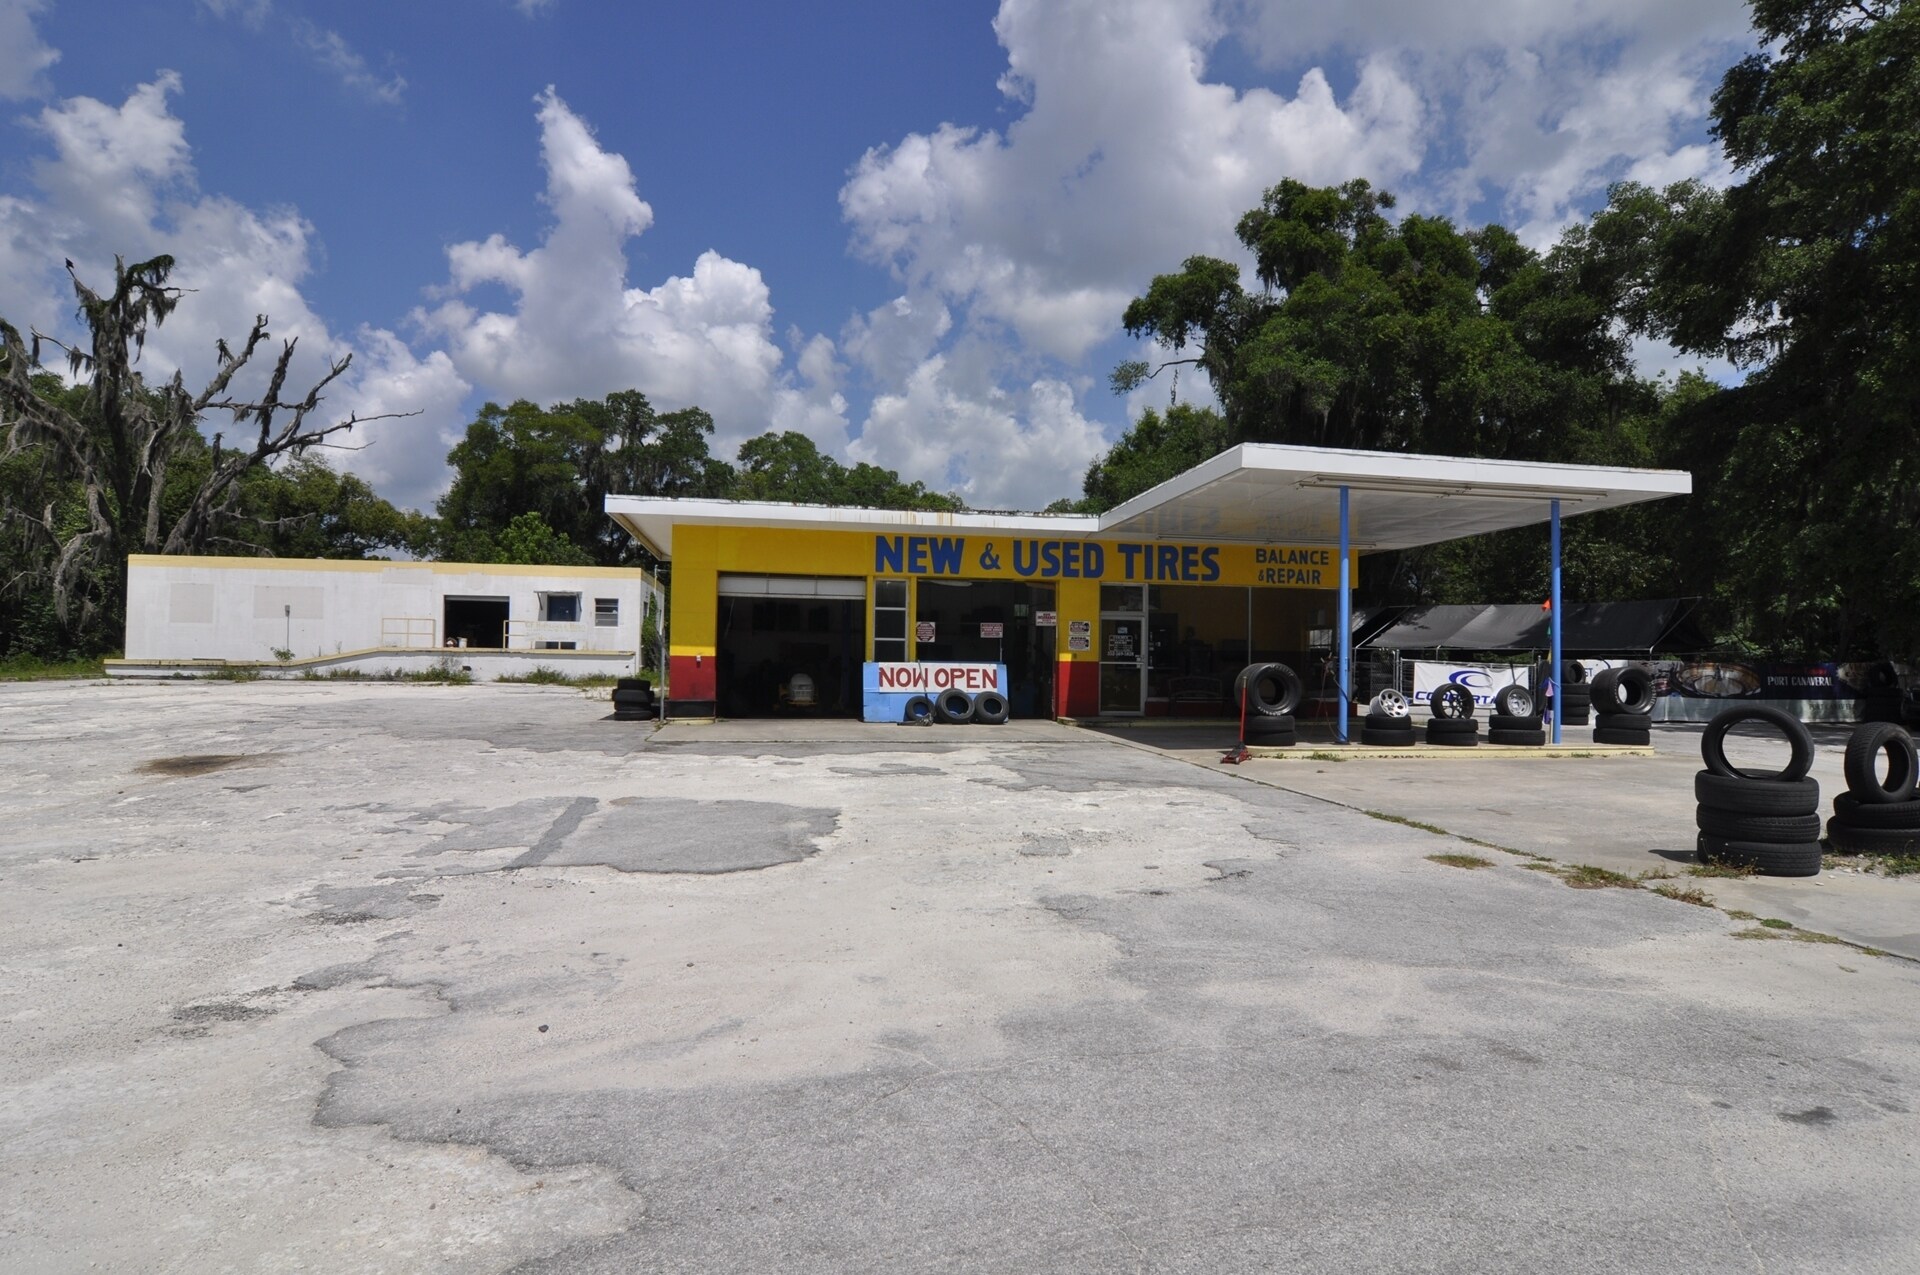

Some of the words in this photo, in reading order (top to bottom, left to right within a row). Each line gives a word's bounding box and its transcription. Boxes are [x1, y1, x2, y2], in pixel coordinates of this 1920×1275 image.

[876, 536, 964, 574] NEW
[980, 543, 1001, 570] &
[1013, 540, 1104, 578] USED
[1118, 544, 1220, 581] TIRES
[1256, 548, 1329, 565] BALANCE
[879, 667, 928, 688] NOW
[934, 668, 997, 689] OPEN
[1767, 676, 1788, 686] PORT
[1791, 676, 1833, 687] CANAVERAL
